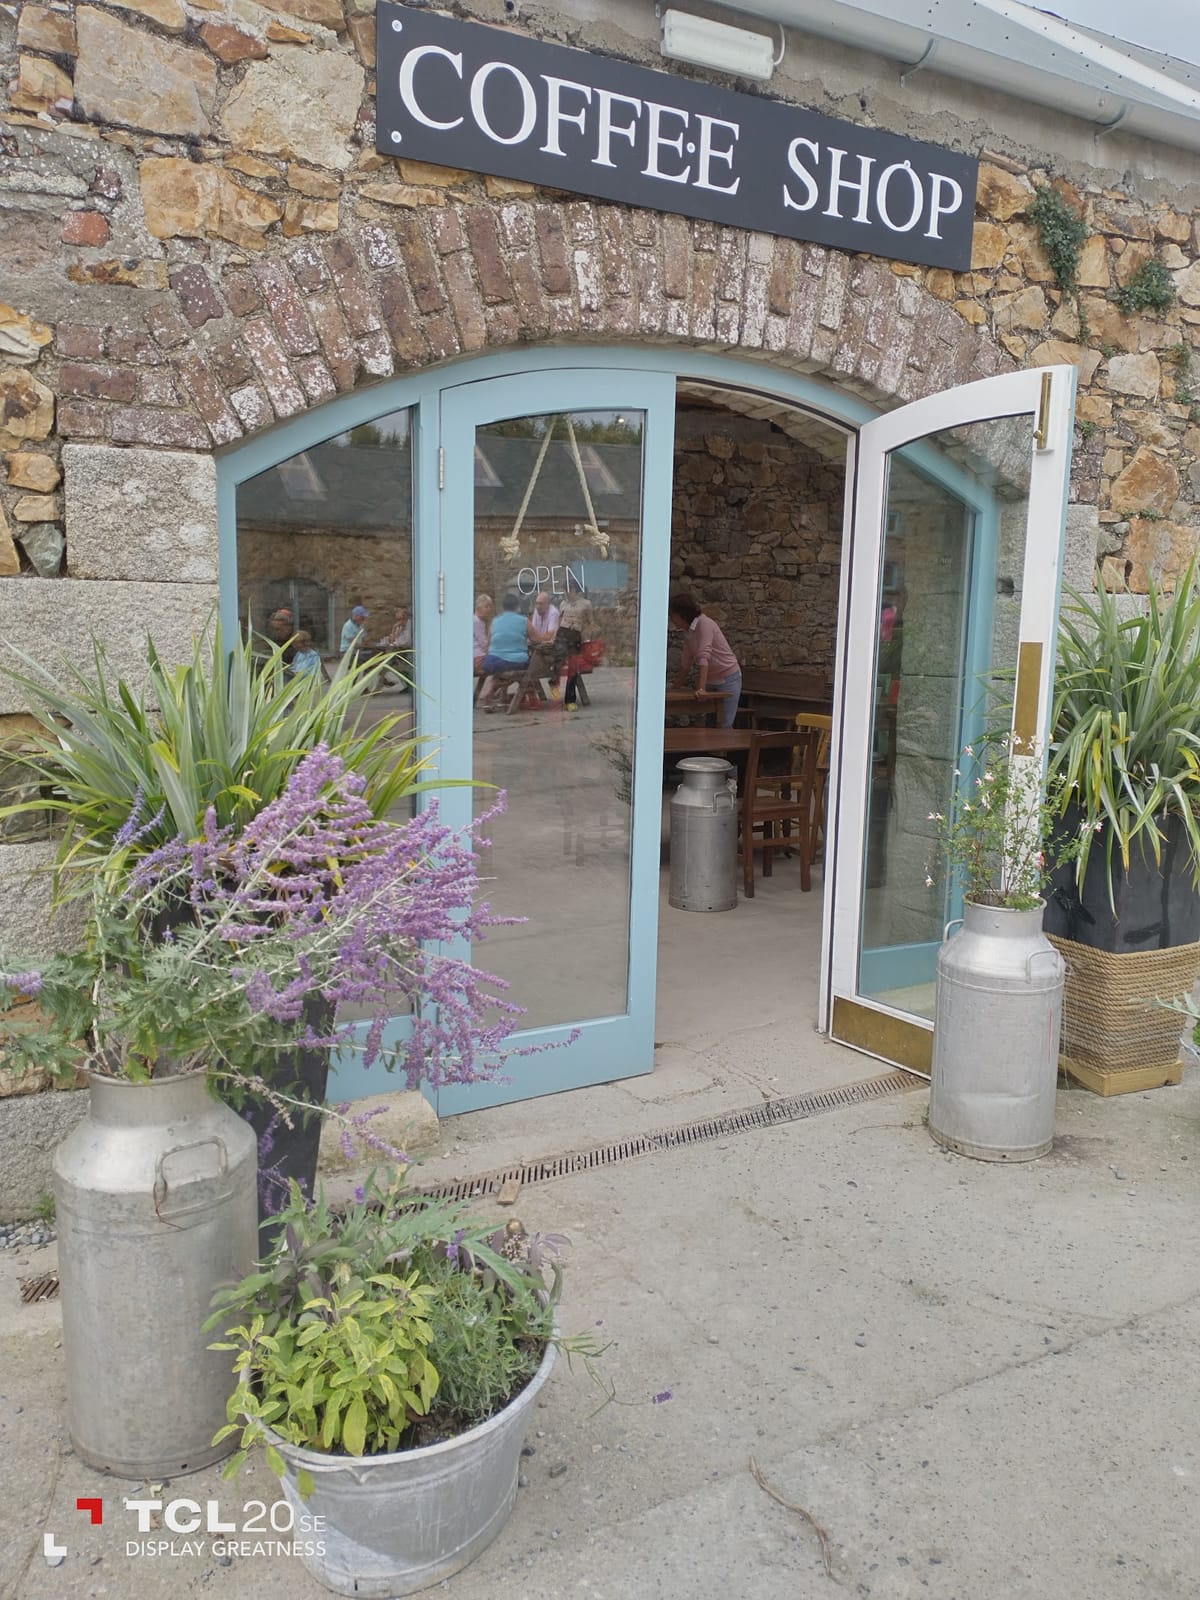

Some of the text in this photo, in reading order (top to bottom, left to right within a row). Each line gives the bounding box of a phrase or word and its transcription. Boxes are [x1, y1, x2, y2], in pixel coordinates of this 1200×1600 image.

[399, 45, 963, 240] COFFEE SHOP
[517, 565, 585, 595] OPEN
